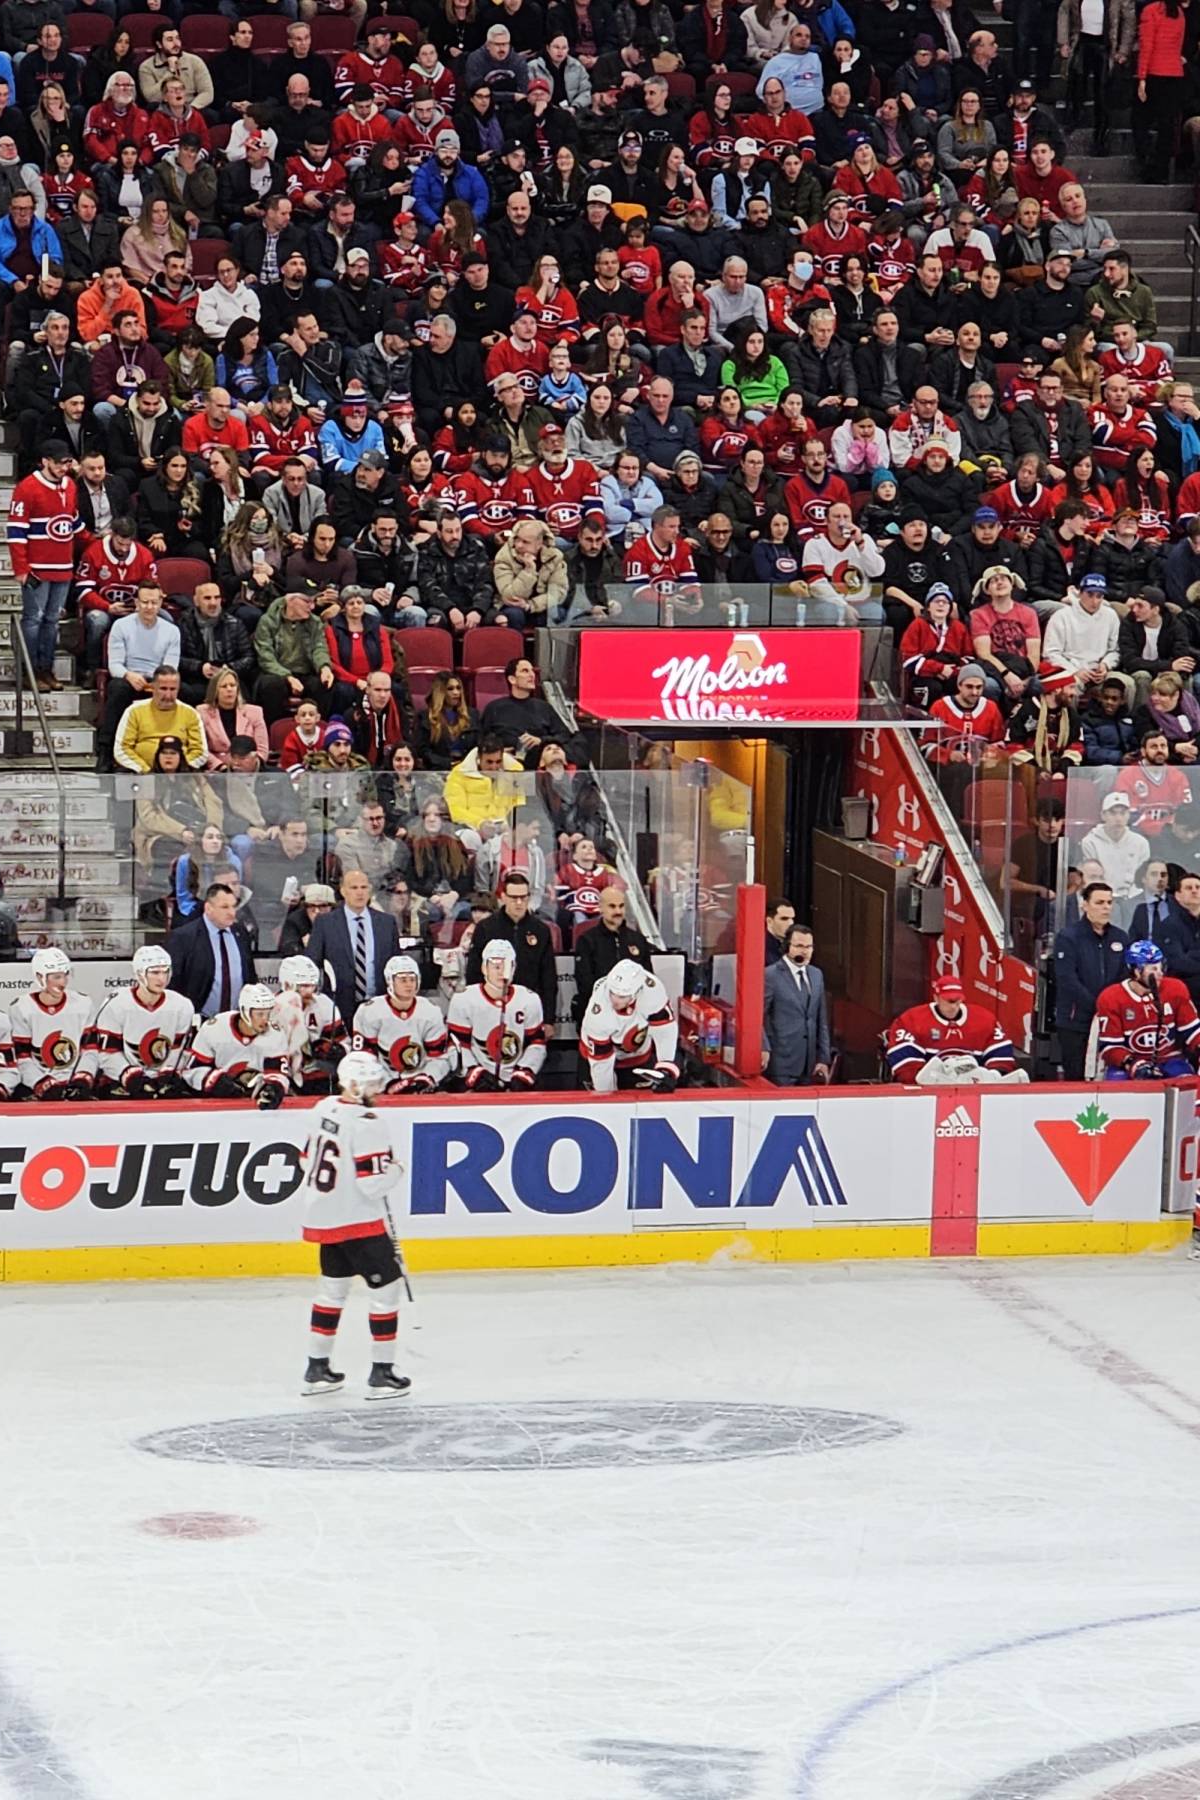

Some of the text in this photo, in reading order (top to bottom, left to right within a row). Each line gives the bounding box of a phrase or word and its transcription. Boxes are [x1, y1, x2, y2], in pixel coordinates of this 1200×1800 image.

[652, 654, 788, 703] Molson
[936, 1126, 979, 1137] adidas
[409, 1115, 848, 1215] RONA
